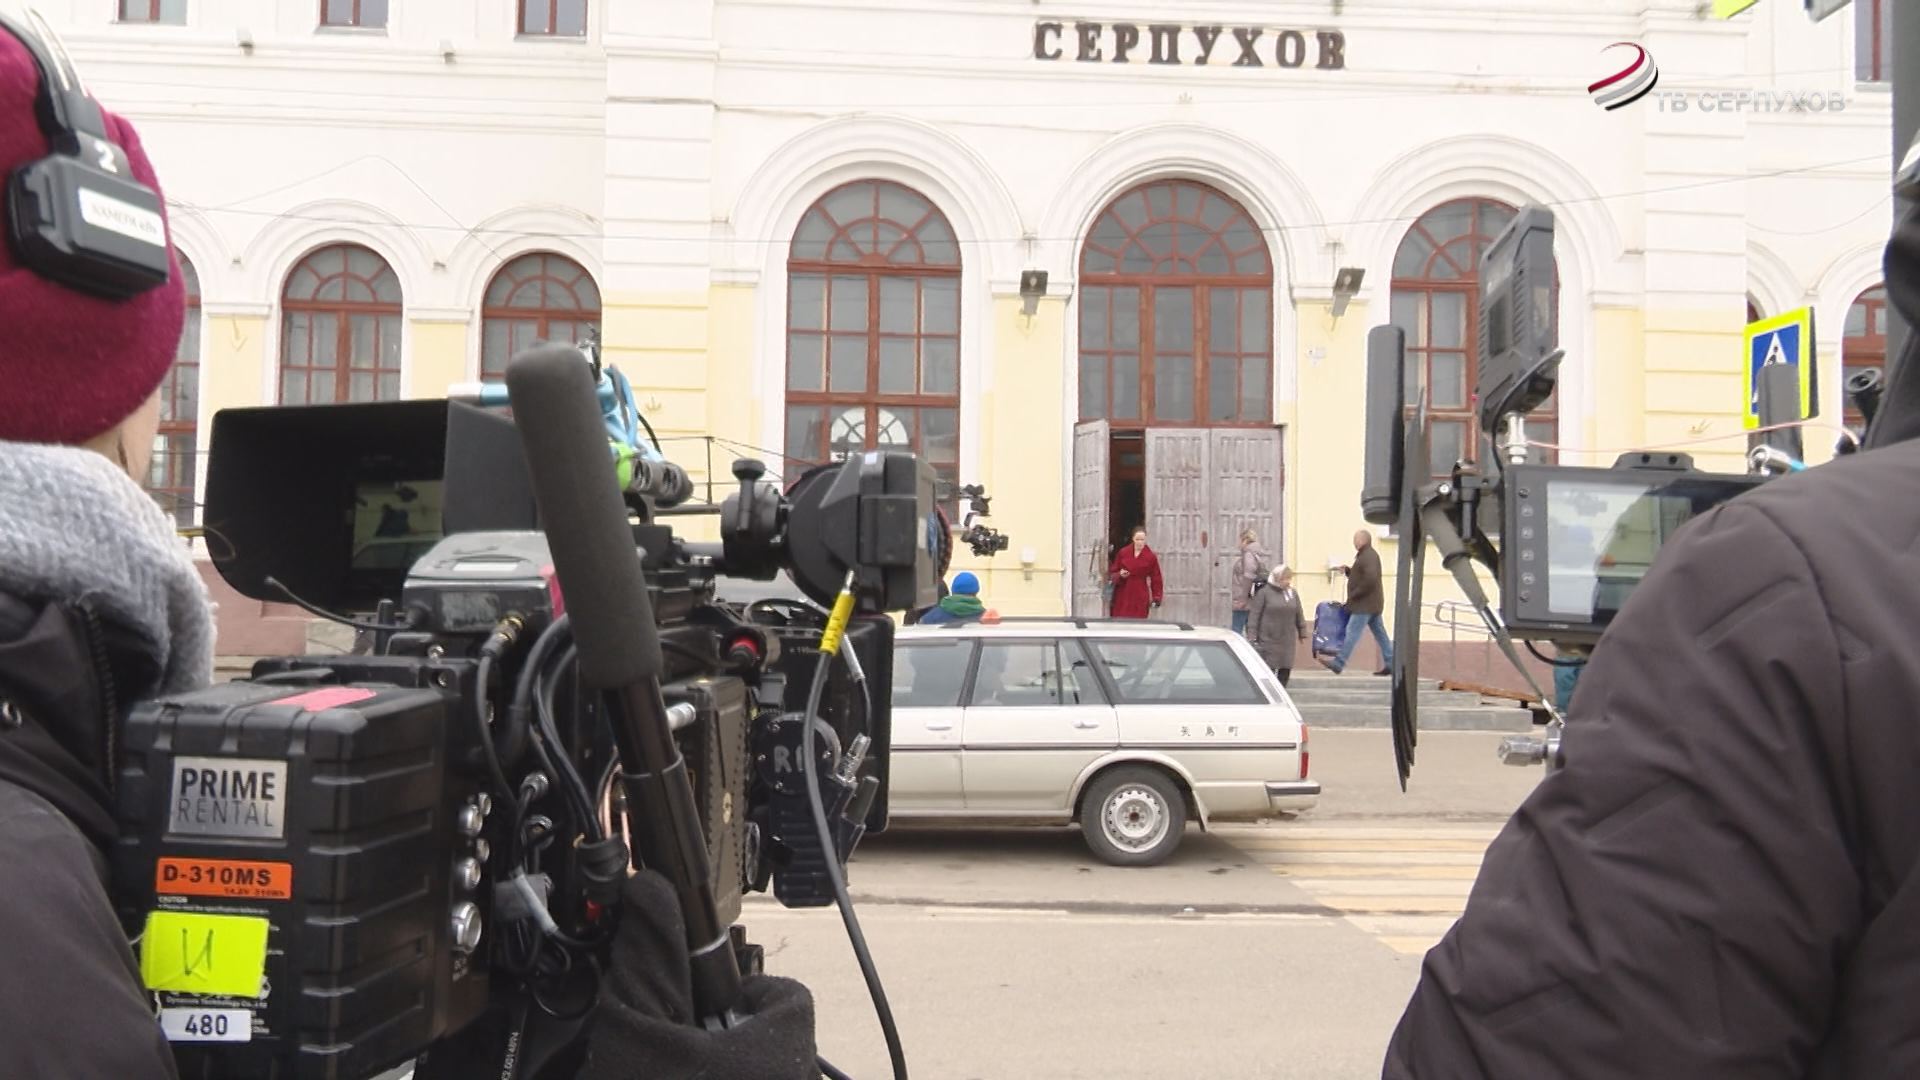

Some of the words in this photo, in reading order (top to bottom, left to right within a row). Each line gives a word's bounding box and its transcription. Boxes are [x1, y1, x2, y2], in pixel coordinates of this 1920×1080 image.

[1034, 22, 1345, 69] СЕРПУХОВ
[94, 140, 118, 173] 2
[180, 768, 275, 800] PRIME
[177, 798, 274, 827] RENTAL
[163, 864, 271, 886] D-310MS
[185, 1014, 228, 1036] 480
